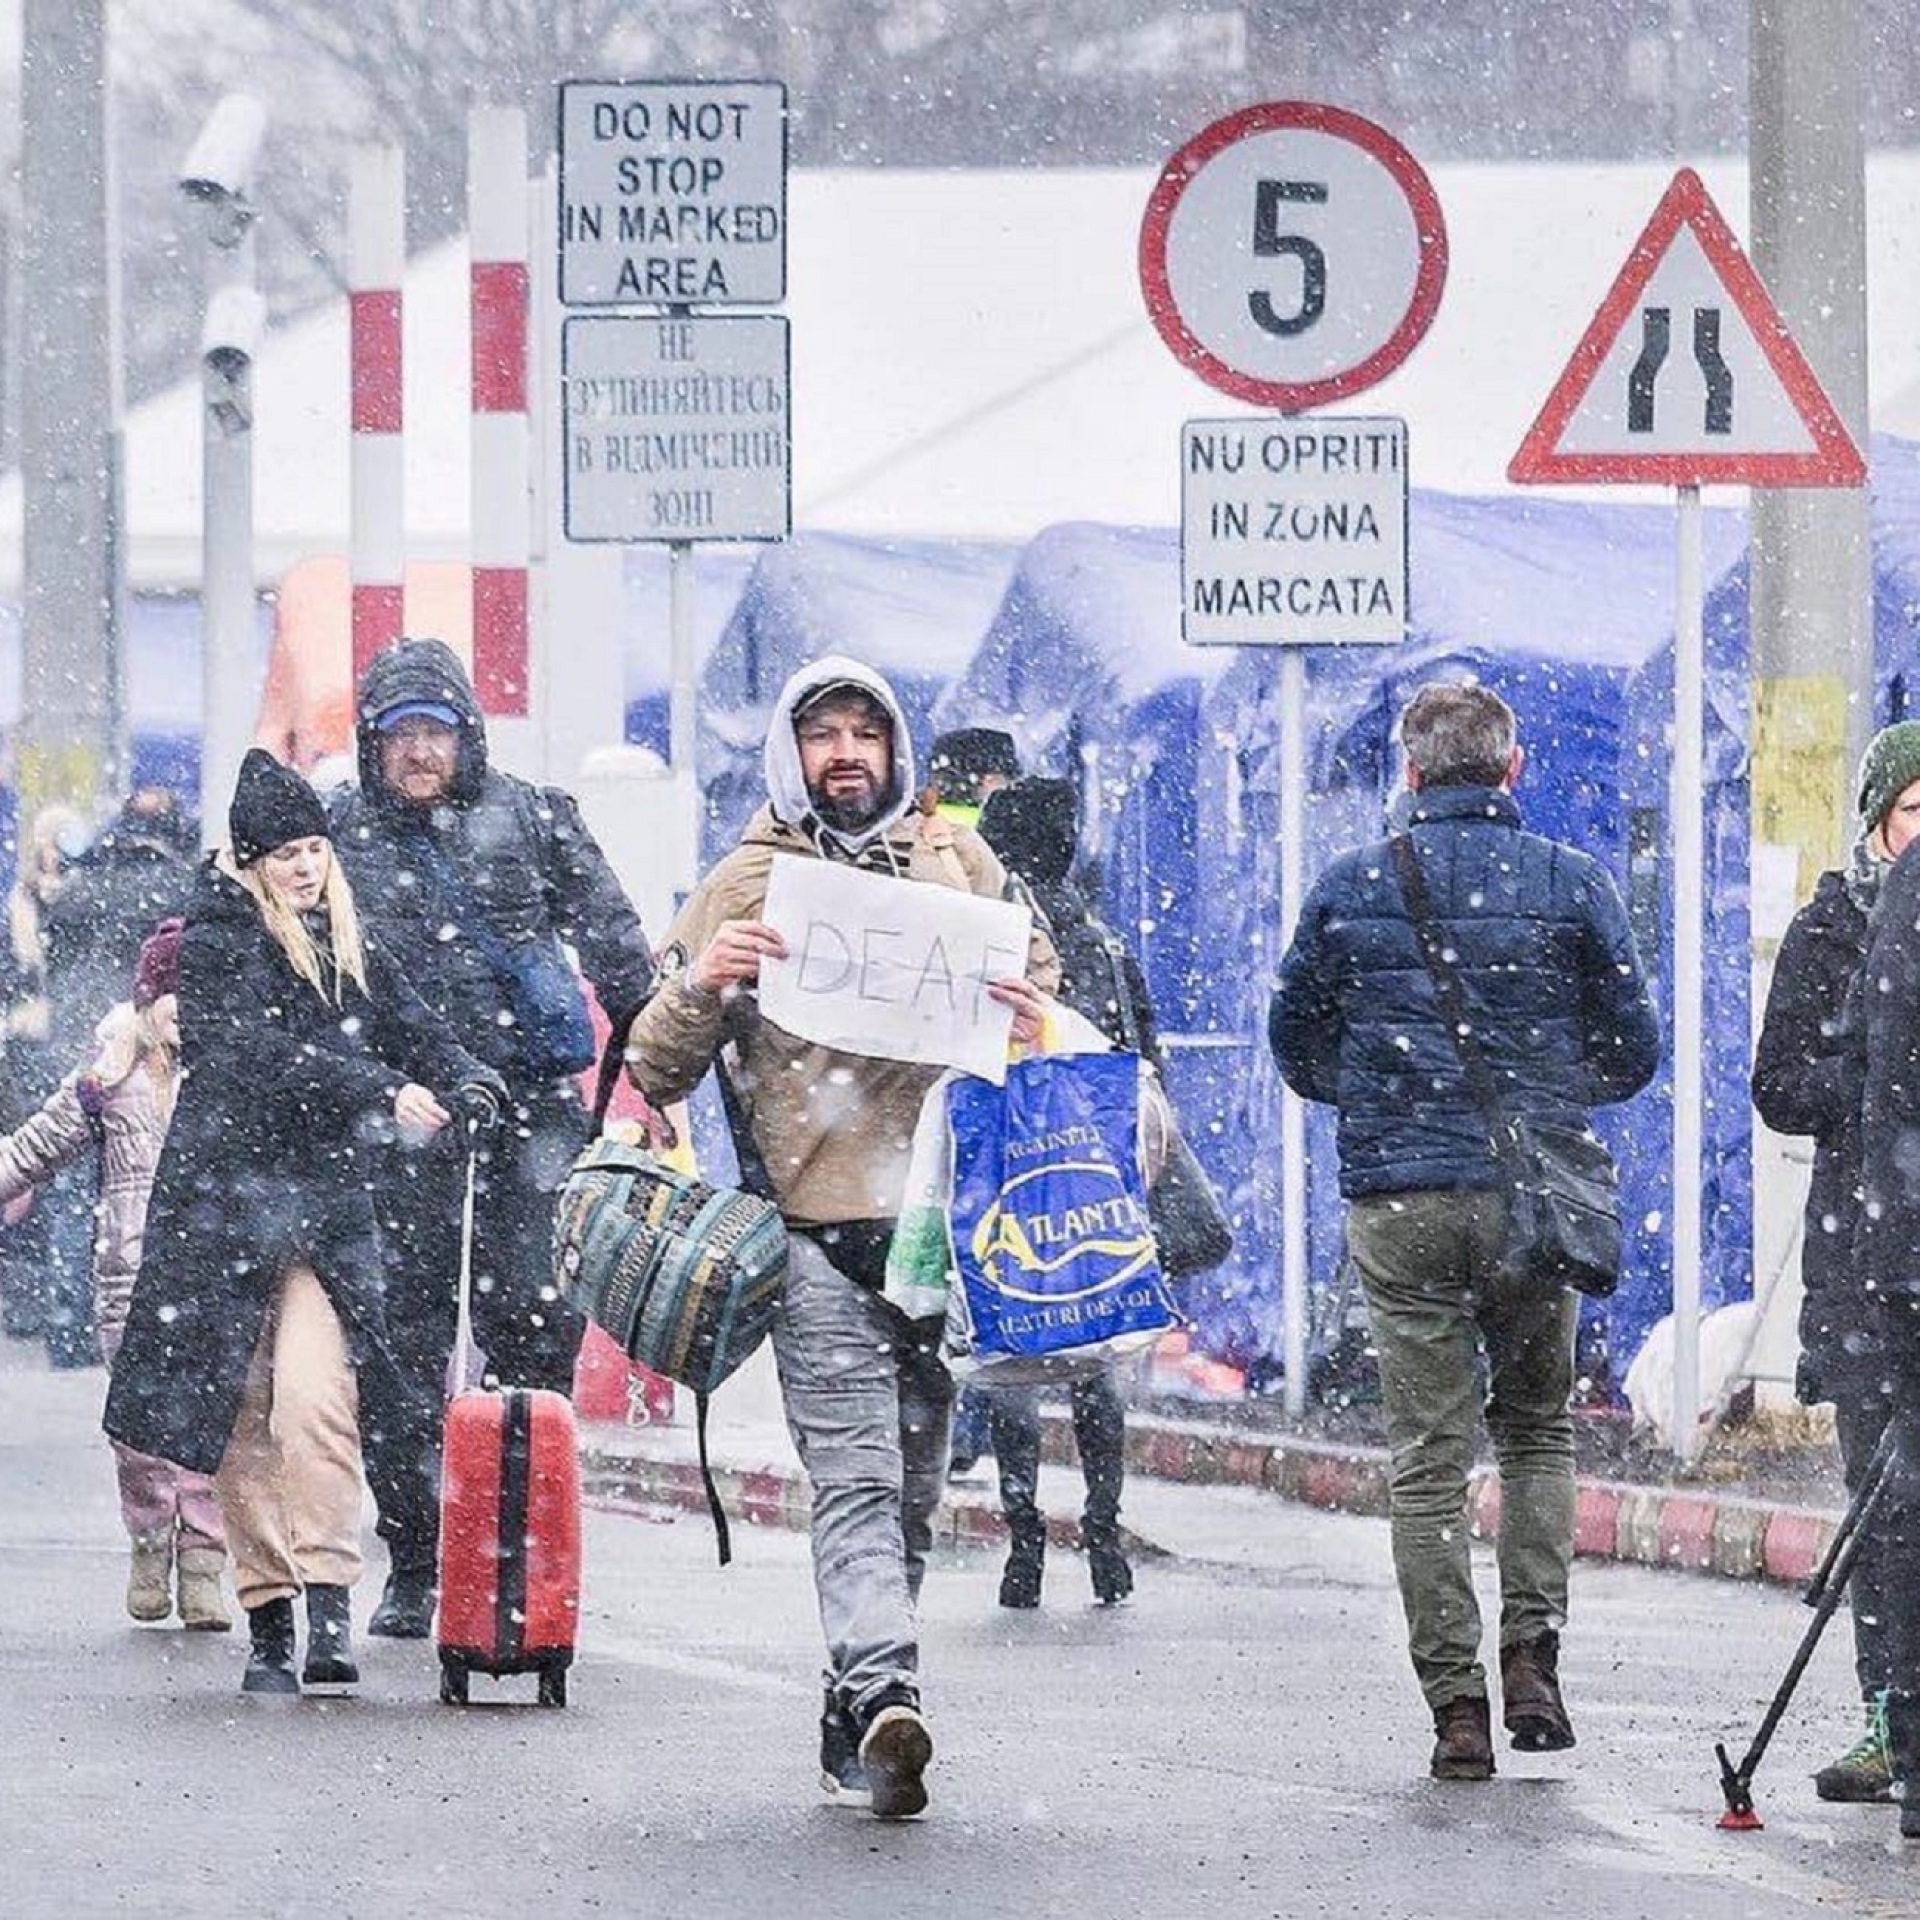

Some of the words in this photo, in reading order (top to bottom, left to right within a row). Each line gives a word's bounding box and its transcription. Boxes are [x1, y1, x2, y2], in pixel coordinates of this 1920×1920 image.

[593, 102, 650, 141] DO
[666, 102, 750, 142] NOT
[617, 156, 725, 197] STOP
[566, 205, 602, 242] IN
[618, 204, 779, 243] MARKED
[615, 256, 729, 297] AREA
[1247, 179, 1329, 337] 5
[658, 324, 695, 361] НЕ
[576, 435, 592, 472] В
[1190, 434, 1245, 474] NU
[1261, 433, 1399, 474] OPRITI
[1210, 502, 1249, 540] IN
[1262, 502, 1380, 541] ZONA
[1193, 577, 1394, 616] MARCATA
[797, 920, 1019, 1026] DEAF
